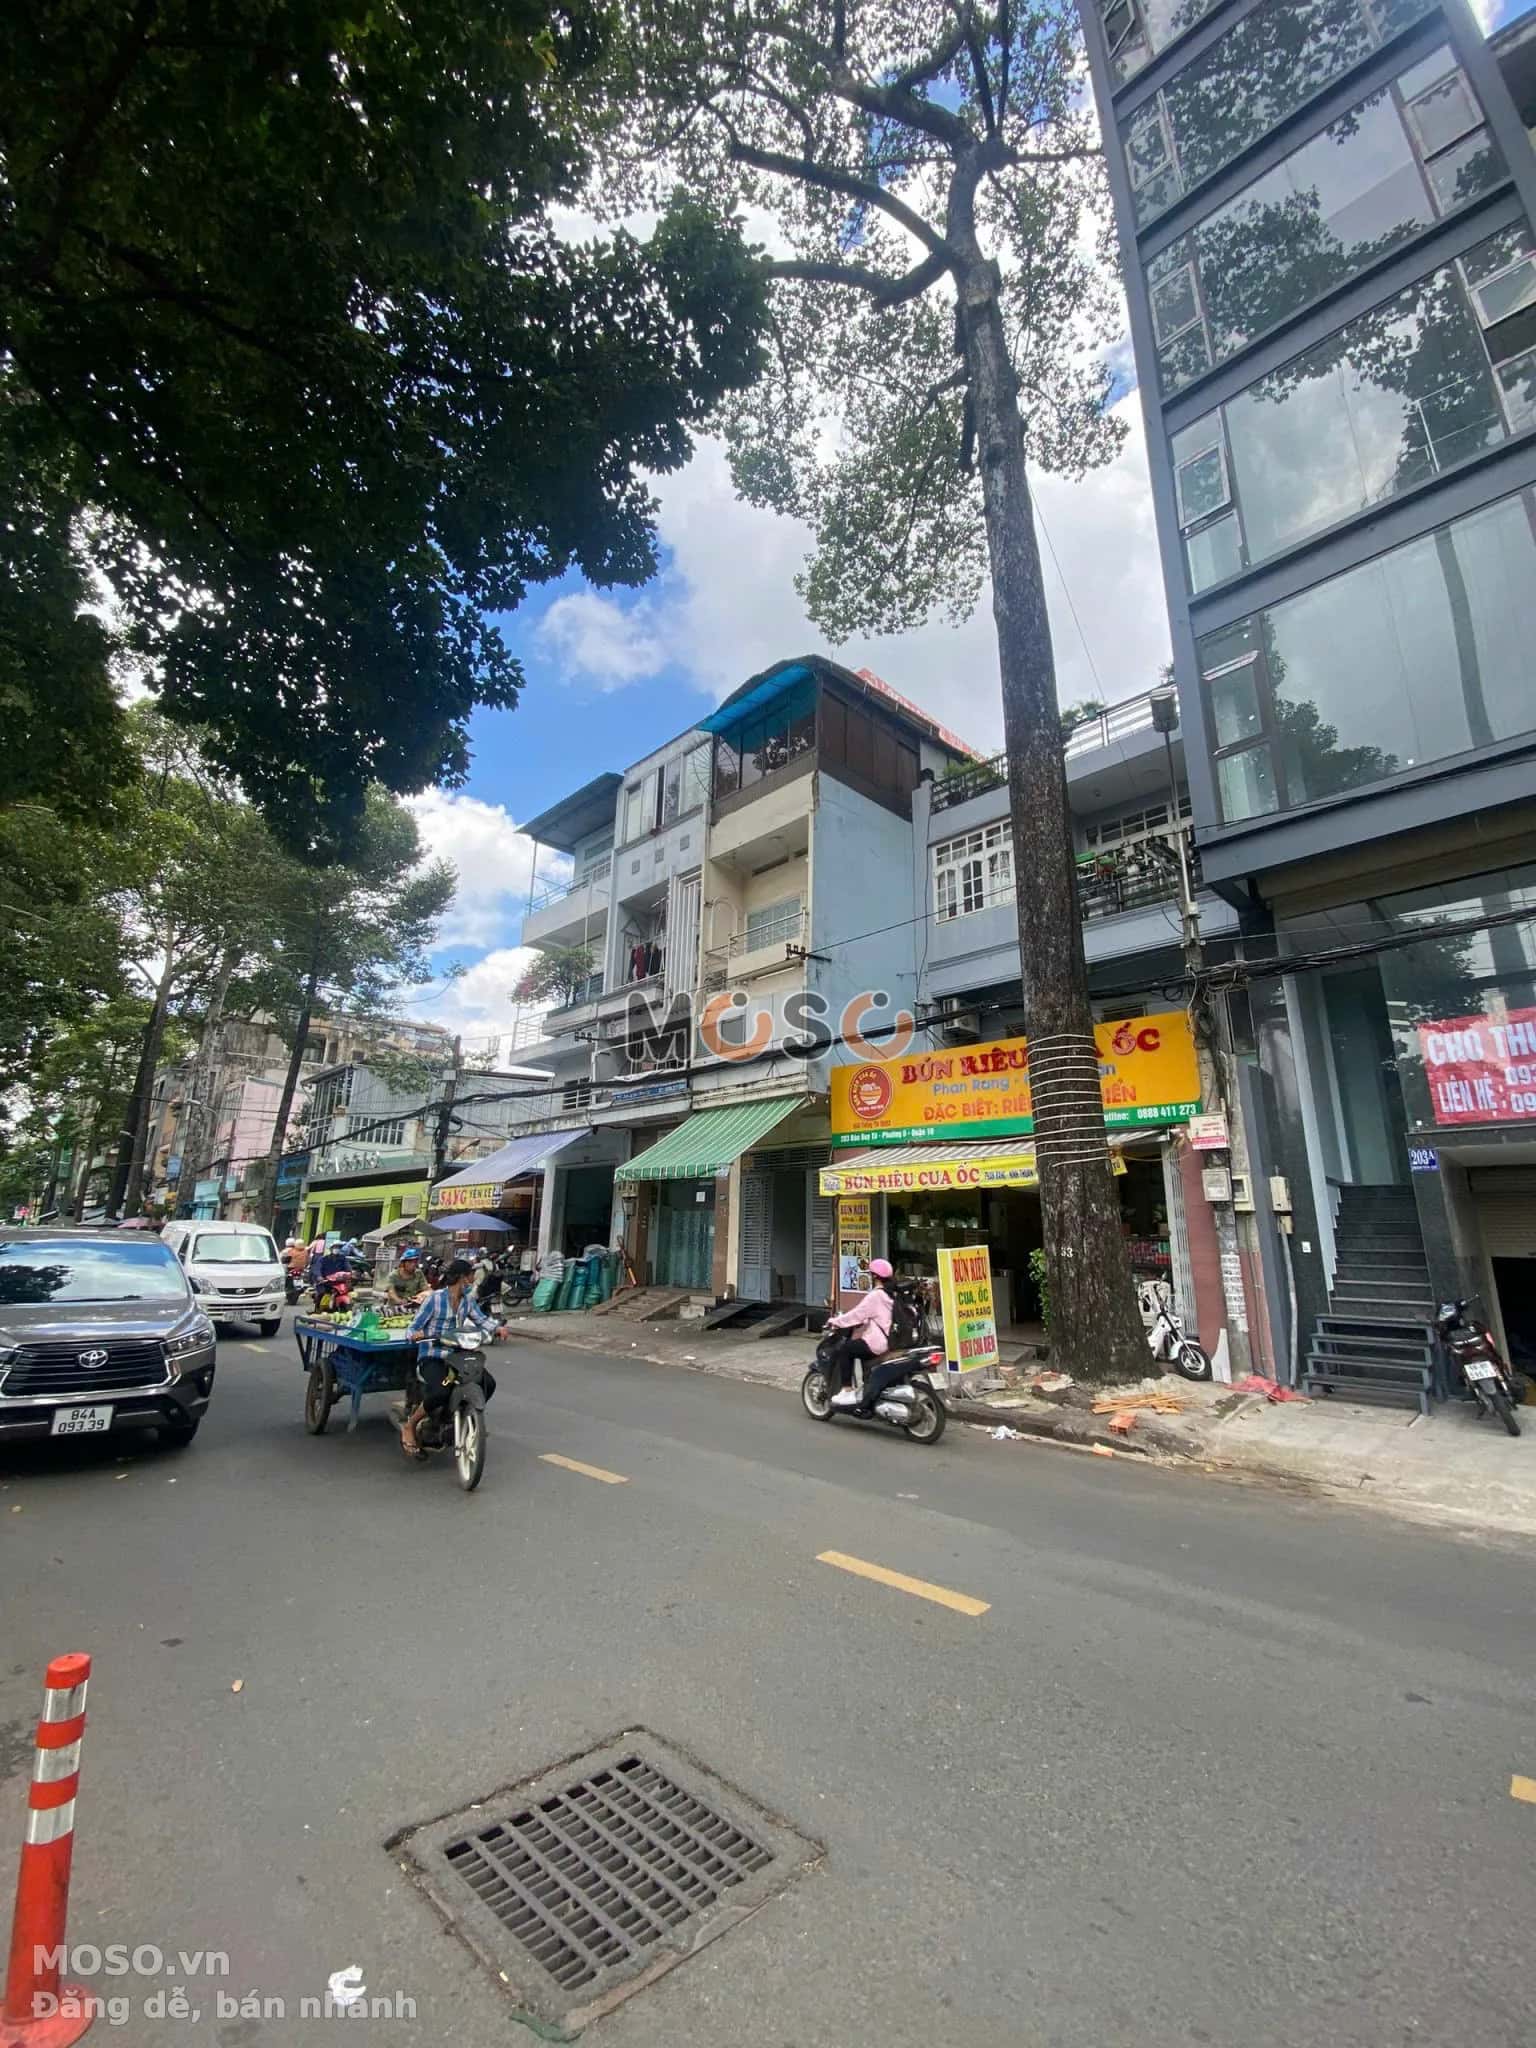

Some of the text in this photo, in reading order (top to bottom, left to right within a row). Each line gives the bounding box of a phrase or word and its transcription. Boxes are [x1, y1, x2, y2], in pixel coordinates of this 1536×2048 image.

[1111, 1022, 1161, 1056] ỐC
[1427, 1029, 1484, 1066] CHO
[901, 1047, 1028, 1084] BÚN RIÊU
[932, 1081, 968, 1096] Phan
[972, 1075, 1009, 1093] Rang
[1437, 1075, 1474, 1113] LIÊN
[923, 1103, 959, 1124] ĐẶC
[1160, 1105, 1177, 1117] 411
[1179, 1103, 1197, 1116] 273
[844, 1173, 874, 1190] BÚN
[877, 1169, 914, 1189] RIÊU
[918, 1168, 953, 1186] CUA
[956, 1161, 981, 1184] ỐC
[57, 1419, 105, 1433] 093.39
[71, 1408, 96, 1421] 84A
